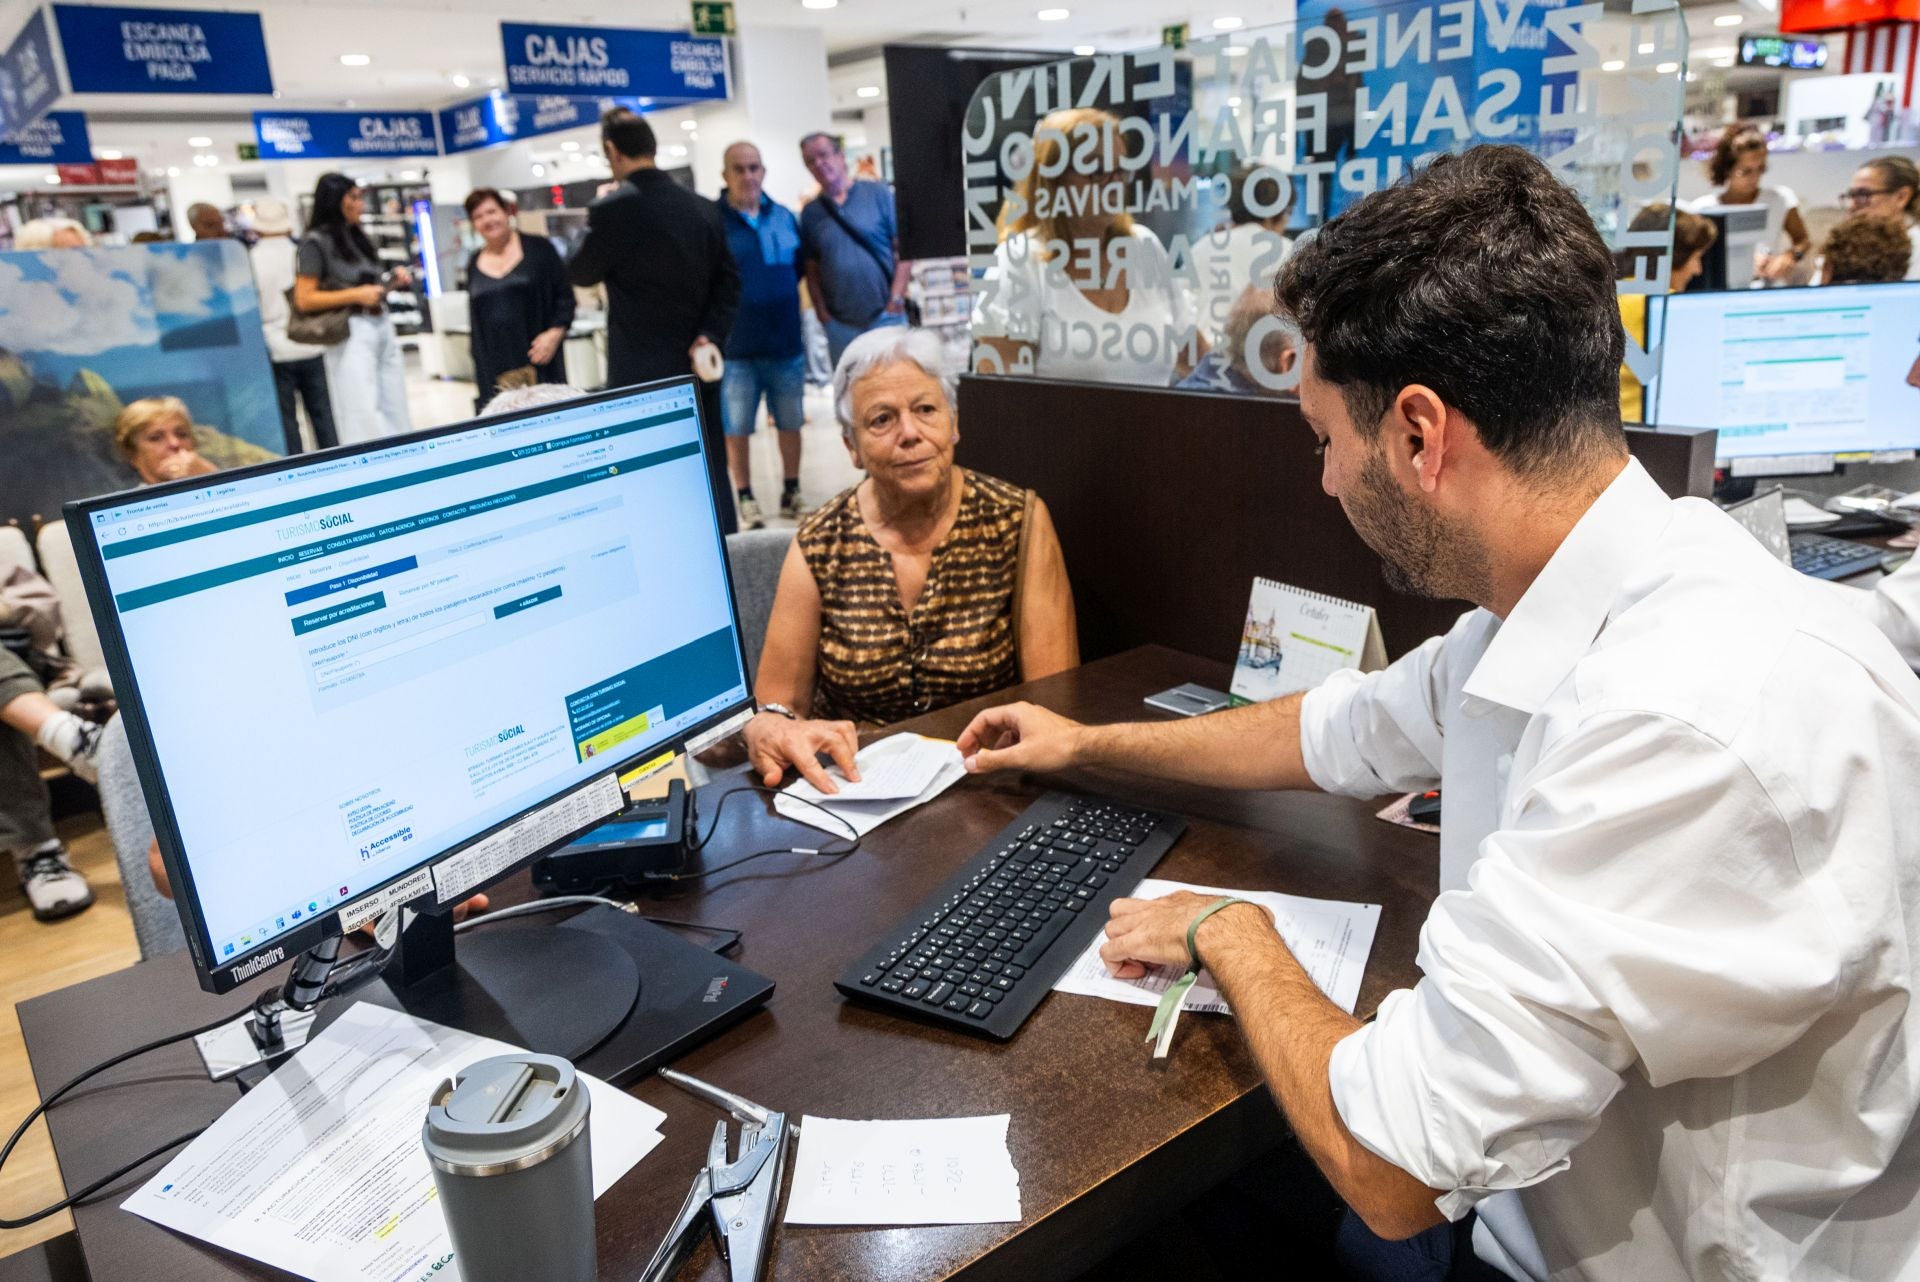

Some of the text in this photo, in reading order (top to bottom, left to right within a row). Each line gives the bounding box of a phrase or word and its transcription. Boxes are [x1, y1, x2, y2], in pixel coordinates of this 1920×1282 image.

[525, 34, 609, 68] CAJAS
[358, 117, 422, 139] CAJAS
[298, 545, 323, 558] RESERVAR
[303, 598, 375, 627] Reservar por acreditaciones
[307, 640, 336, 656] Introduce
[336, 637, 346, 646] los
[346, 632, 359, 643] DNI
[369, 824, 411, 850] Accessible
[388, 873, 427, 896] MUNDORED
[346, 897, 379, 918] IMSERSO
[230, 946, 285, 983] ThinkCentre
